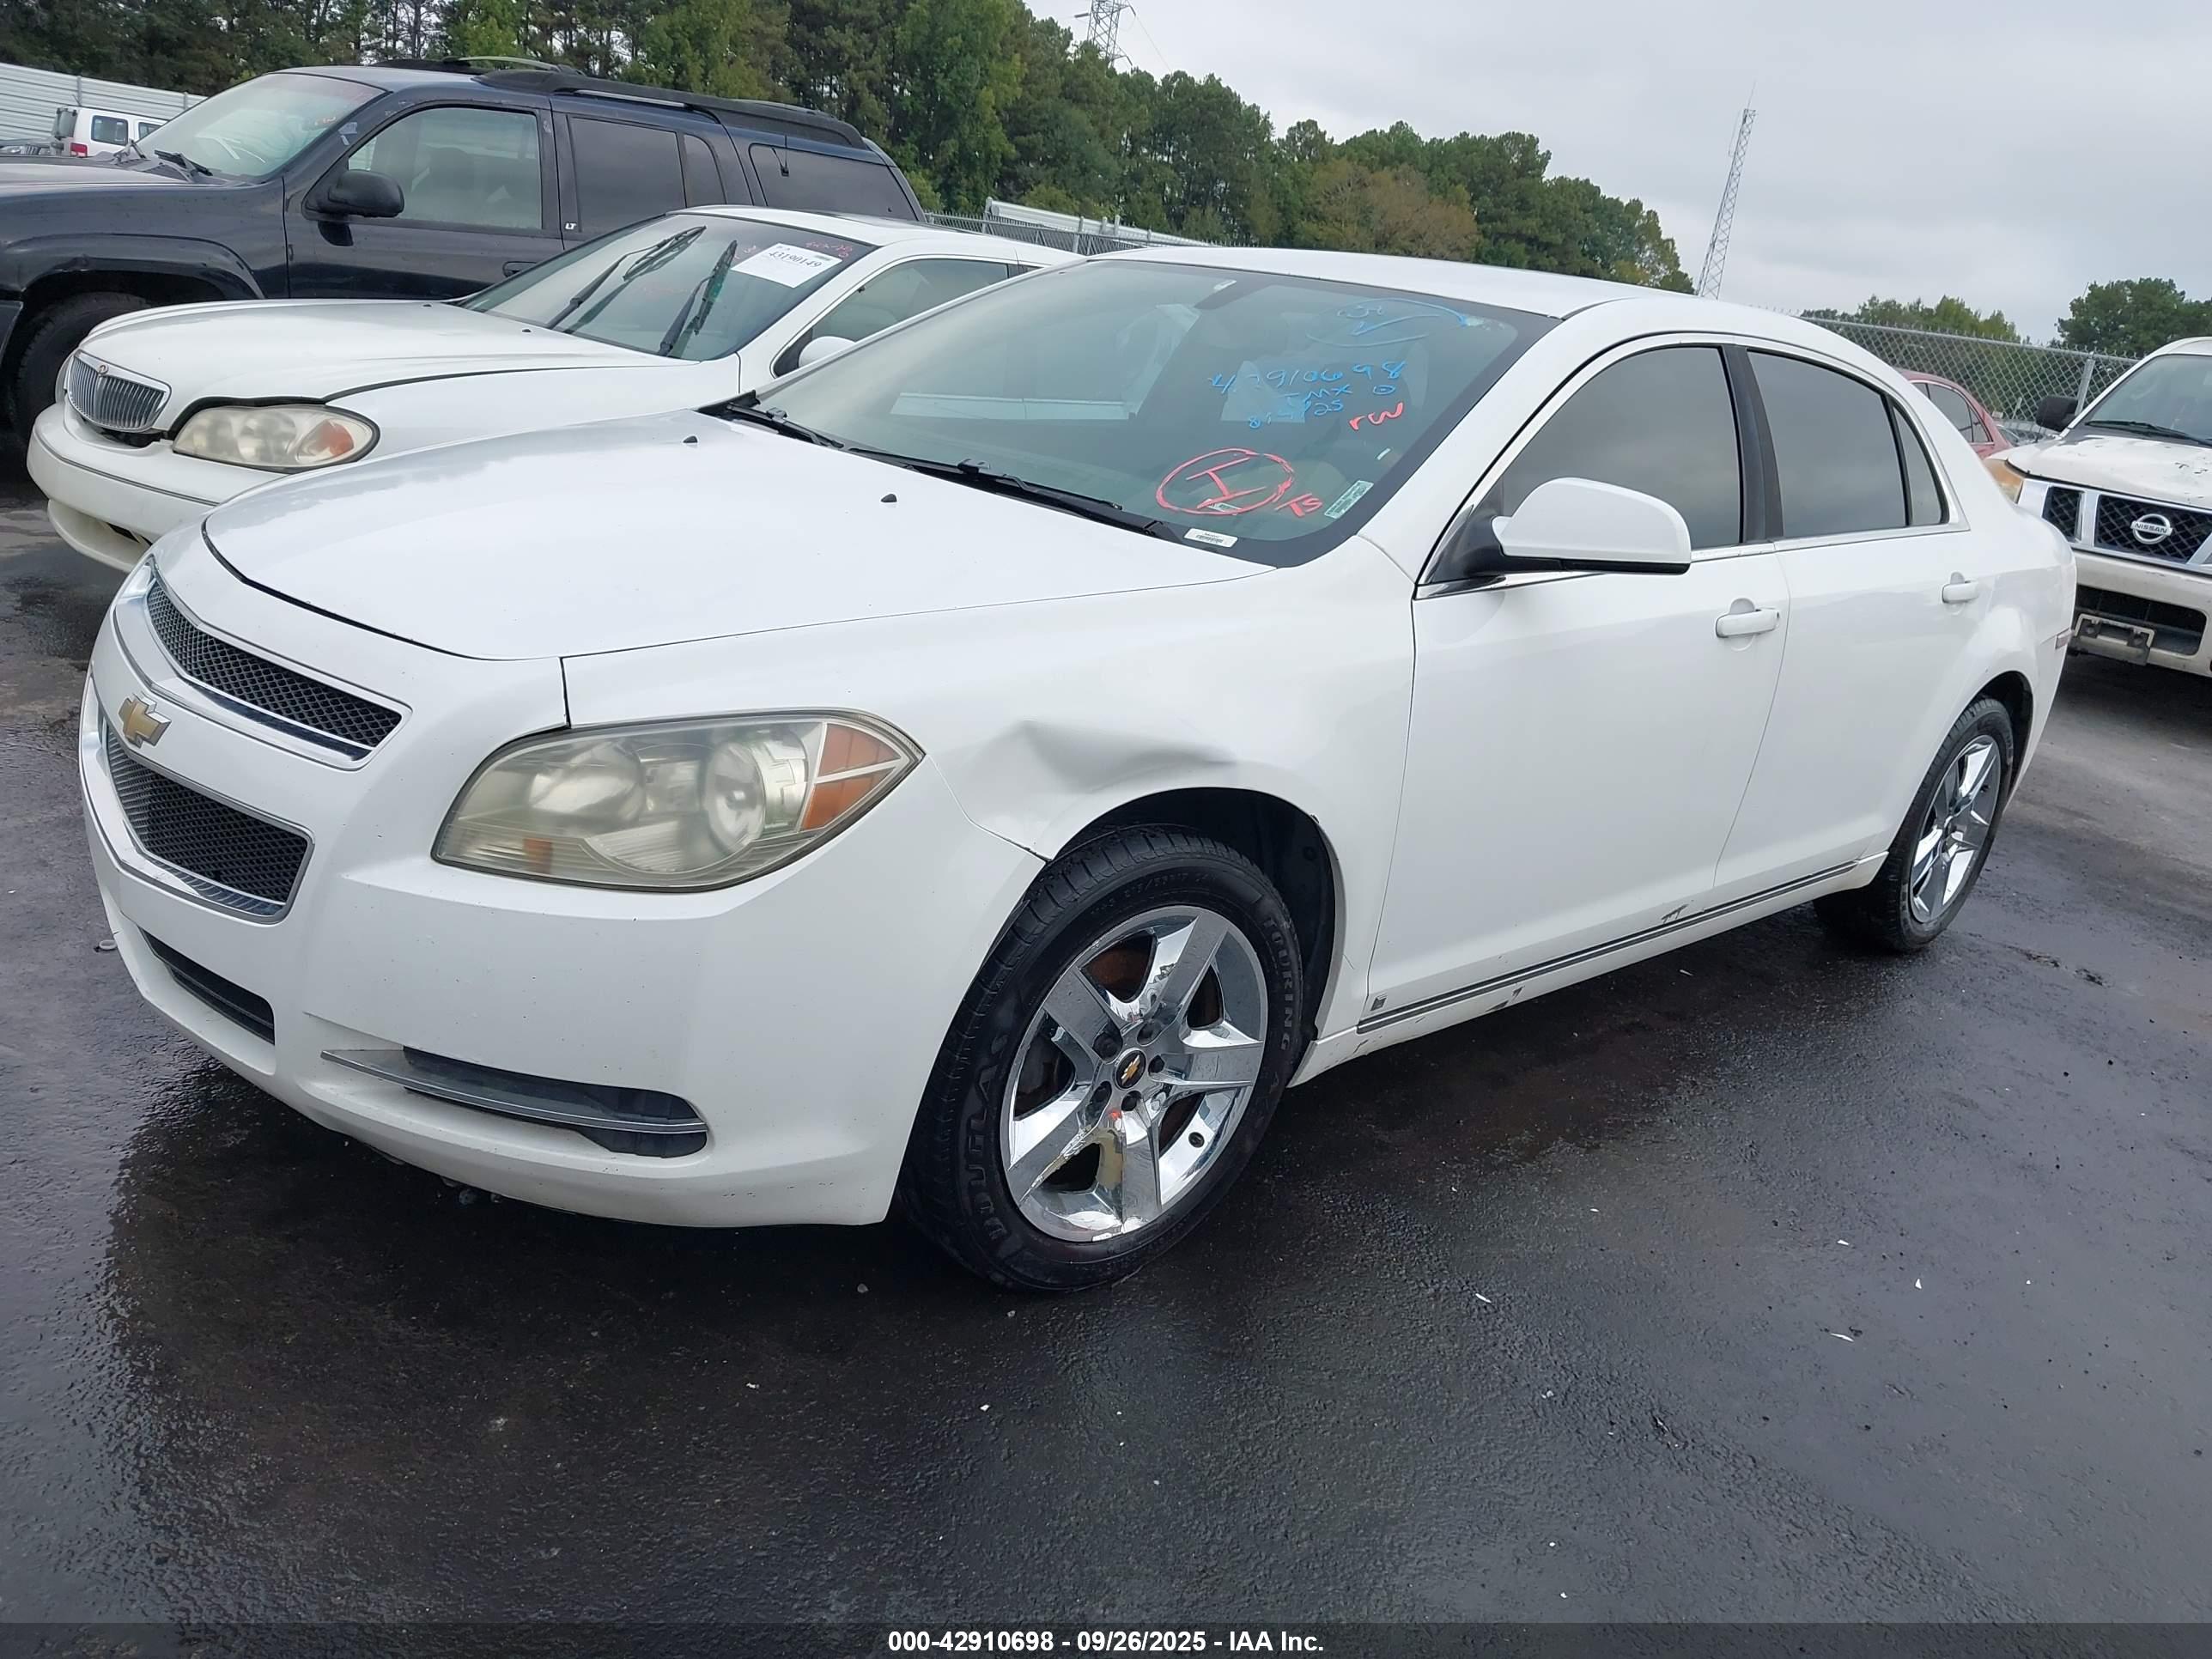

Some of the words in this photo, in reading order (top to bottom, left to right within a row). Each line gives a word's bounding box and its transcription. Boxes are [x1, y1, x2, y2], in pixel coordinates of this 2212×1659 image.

[769, 251, 823, 268] 43190149
[2135, 522, 2167, 533] NISSAN
[1262, 917, 1293, 1051] TOURING
[967, 1033, 1011, 1242] DOUGLAS
